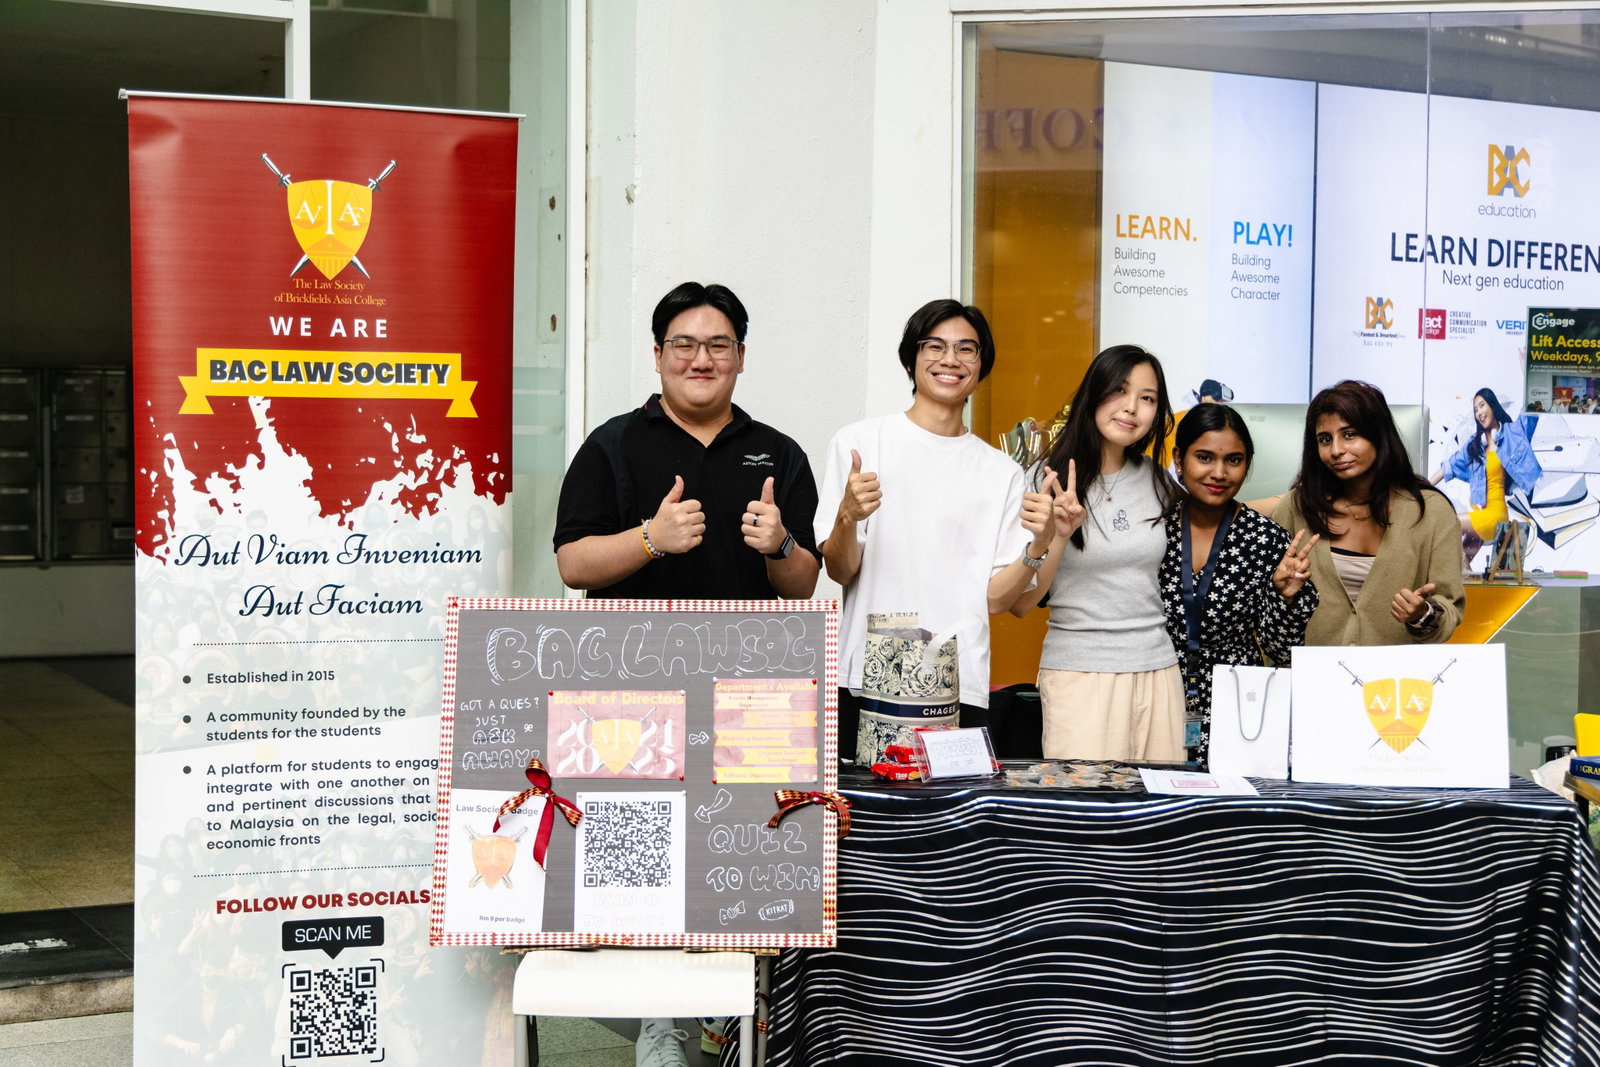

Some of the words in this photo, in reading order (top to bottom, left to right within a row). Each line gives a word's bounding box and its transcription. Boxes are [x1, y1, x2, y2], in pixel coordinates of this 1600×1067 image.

[1487, 144, 1531, 198] BAC
[1478, 203, 1536, 219] education
[1115, 213, 1198, 242] LEARN.
[1233, 220, 1293, 248] PLAY!
[1114, 247, 1156, 265] Building
[1391, 232, 1477, 266] LEARN
[1231, 253, 1271, 270] Building
[1114, 265, 1165, 278] Awesome
[1231, 270, 1280, 284] Awesome
[1442, 269, 1472, 286] Next
[1475, 275, 1499, 292] gen
[1503, 273, 1564, 291] education
[293, 278, 312, 289] The
[314, 279, 333, 290] Law
[334, 280, 366, 292] Society
[1113, 281, 1188, 298] Competencies
[1231, 287, 1280, 301] Character
[274, 293, 284, 303] of
[286, 293, 332, 304] Brickfields
[333, 294, 353, 305] Asia
[354, 295, 387, 306] College
[1365, 297, 1393, 330] BAC
[1425, 315, 1442, 329] act
[1533, 314, 1575, 328] Engage
[269, 316, 313, 337] WE
[330, 318, 388, 339] ARE
[1449, 319, 1487, 327] COMMUNICATION
[1532, 335, 1553, 347] Lift
[1531, 351, 1592, 364] Weekdays,
[209, 359, 268, 383] BAC
[271, 361, 337, 385] LAW
[338, 362, 452, 386] SOCIETY
[173, 533, 241, 567] Aut
[247, 533, 329, 566] Viam
[238, 584, 303, 618] Aut
[308, 583, 424, 615] Faciam
[487, 624, 613, 684] BAC
[206, 671, 288, 685] Established
[291, 670, 304, 682] in
[306, 670, 335, 682] 2015
[460, 699, 482, 711] GOT
[488, 699, 496, 710] A
[553, 692, 596, 705] Board
[601, 692, 617, 705] of
[621, 692, 684, 705] Directors
[206, 712, 216, 723] A
[219, 709, 298, 724] community
[301, 705, 360, 720] founded
[362, 705, 380, 721] by
[384, 704, 406, 718] the
[923, 705, 956, 716] CHAGEE
[475, 714, 507, 727] JUST
[206, 728, 268, 742] students
[272, 727, 292, 739] for
[295, 726, 317, 738] the
[320, 724, 382, 738] students
[472, 727, 516, 745] ASK
[206, 764, 216, 776] A
[220, 761, 283, 777] platform
[286, 760, 307, 772] for
[311, 758, 372, 772] students
[376, 758, 391, 770] to
[206, 780, 273, 795] integrate
[280, 778, 310, 790] with
[317, 778, 343, 789] one
[350, 775, 406, 788] another
[412, 776, 430, 786] on
[206, 800, 235, 812] and
[242, 798, 307, 814] pertinent
[314, 794, 394, 808] discussions
[401, 793, 431, 804] that
[456, 804, 474, 812] Law
[476, 805, 499, 814] Socie
[206, 820, 221, 831] to
[229, 816, 294, 832] Malaysia
[302, 815, 320, 827] on
[327, 813, 350, 826] the
[358, 812, 396, 826] legal,
[206, 837, 276, 850] economic
[279, 834, 320, 846] fronts
[708, 822, 807, 855] QUIZ
[706, 866, 743, 892] TO
[216, 895, 298, 915] FOLLOW
[302, 893, 343, 910] OUR
[347, 889, 431, 907] SOCIALS
[765, 903, 788, 916] KITKAT
[294, 927, 342, 943] SCAN
[345, 925, 372, 940] ME
